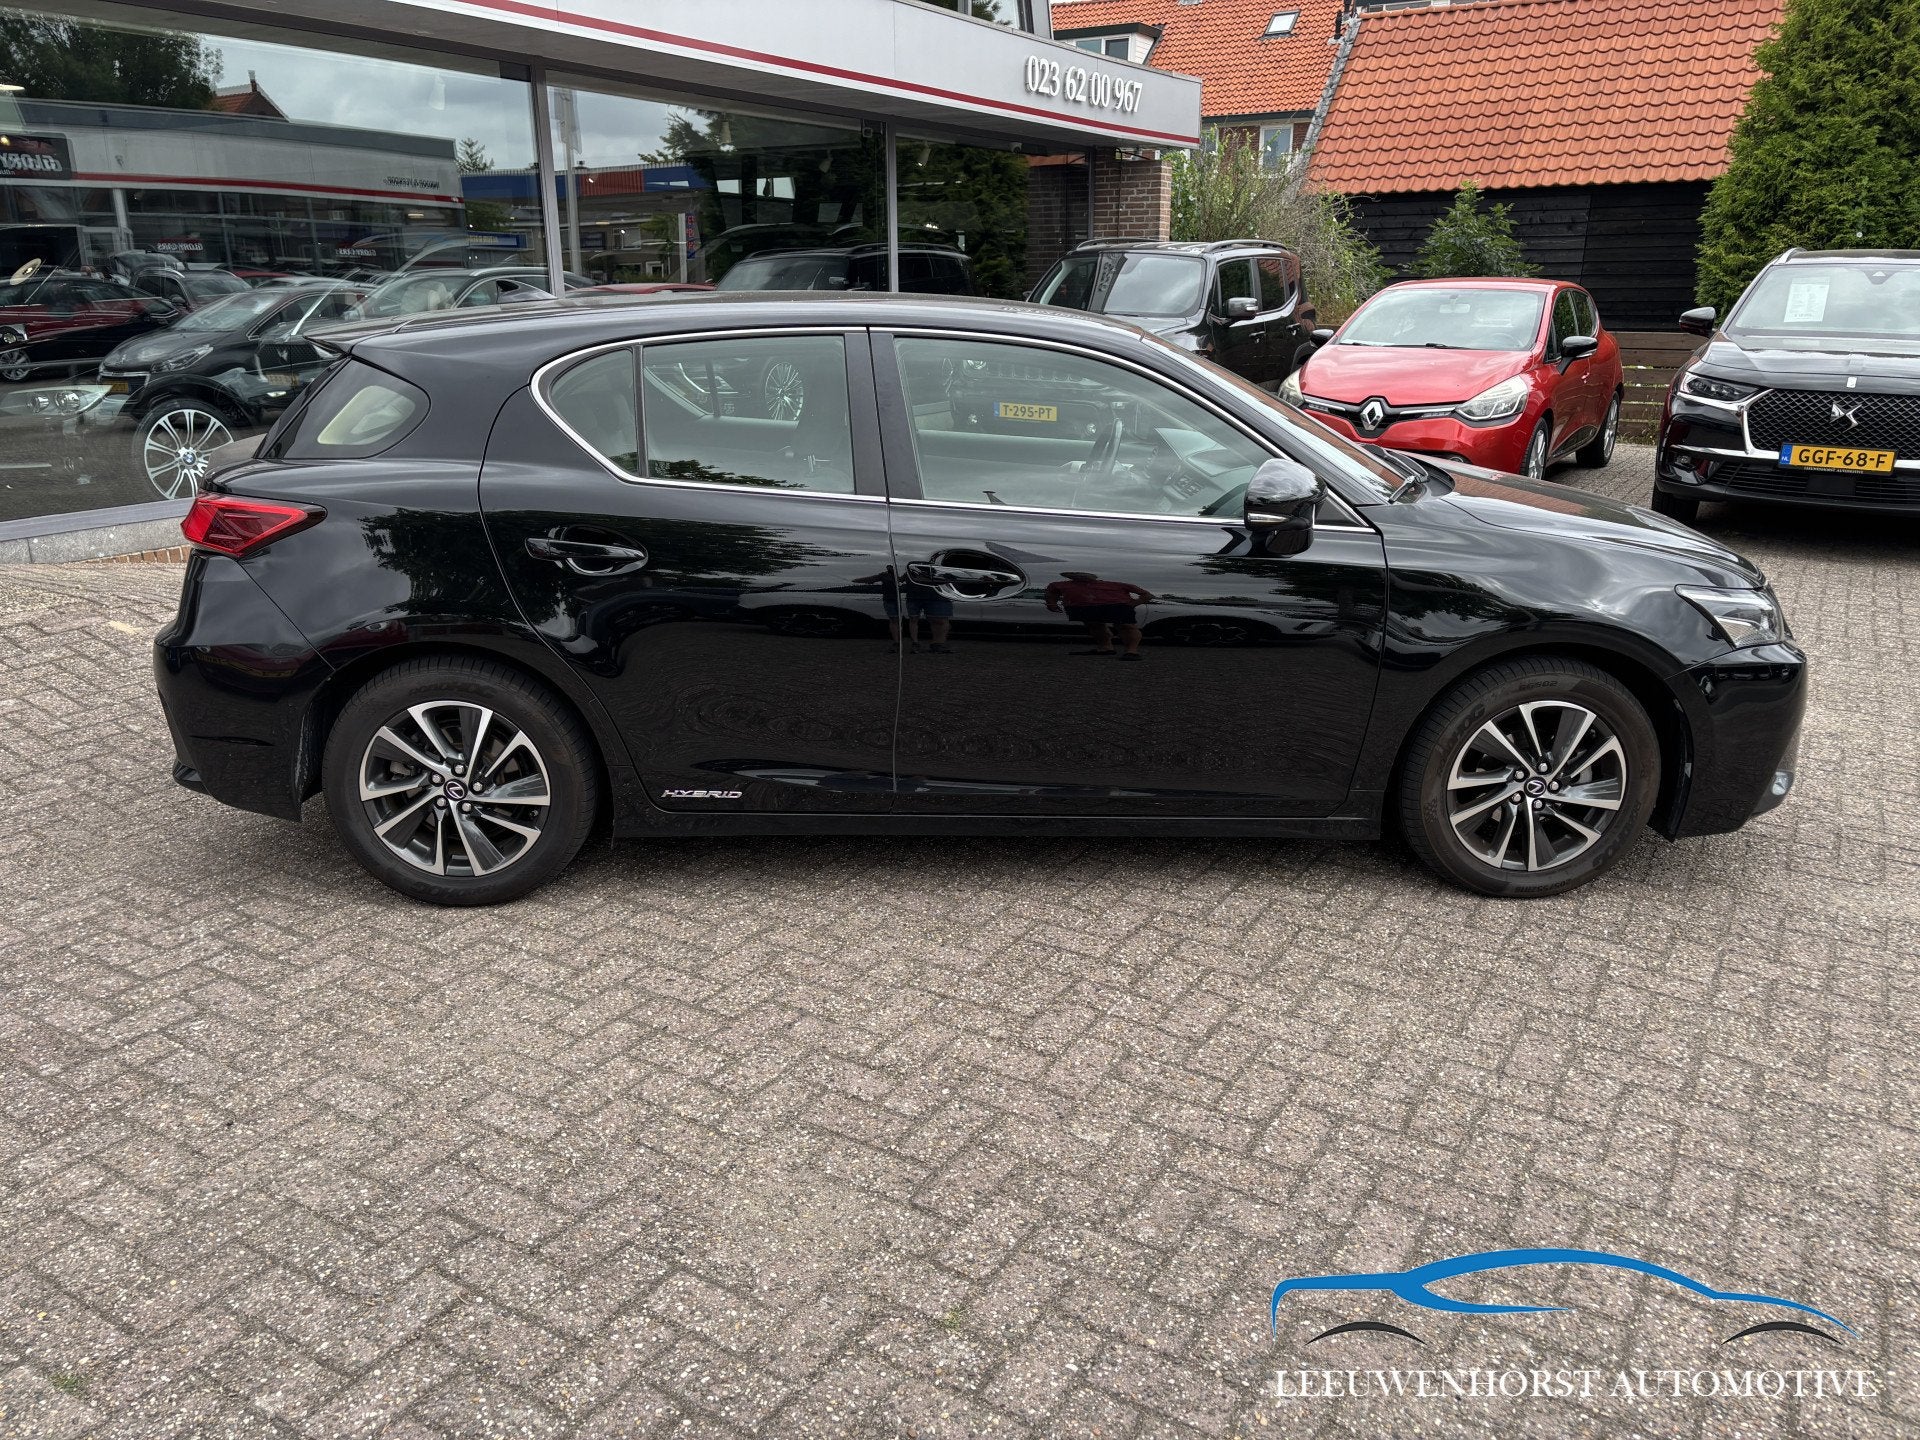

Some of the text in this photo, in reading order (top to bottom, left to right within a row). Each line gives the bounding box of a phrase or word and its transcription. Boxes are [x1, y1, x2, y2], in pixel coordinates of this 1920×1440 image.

[1027, 55, 1143, 113] 023 62 00 967
[1002, 404, 1053, 419] T-295-PT
[1798, 448, 1887, 468] GGF-68-F
[661, 789, 743, 799] HYBRID
